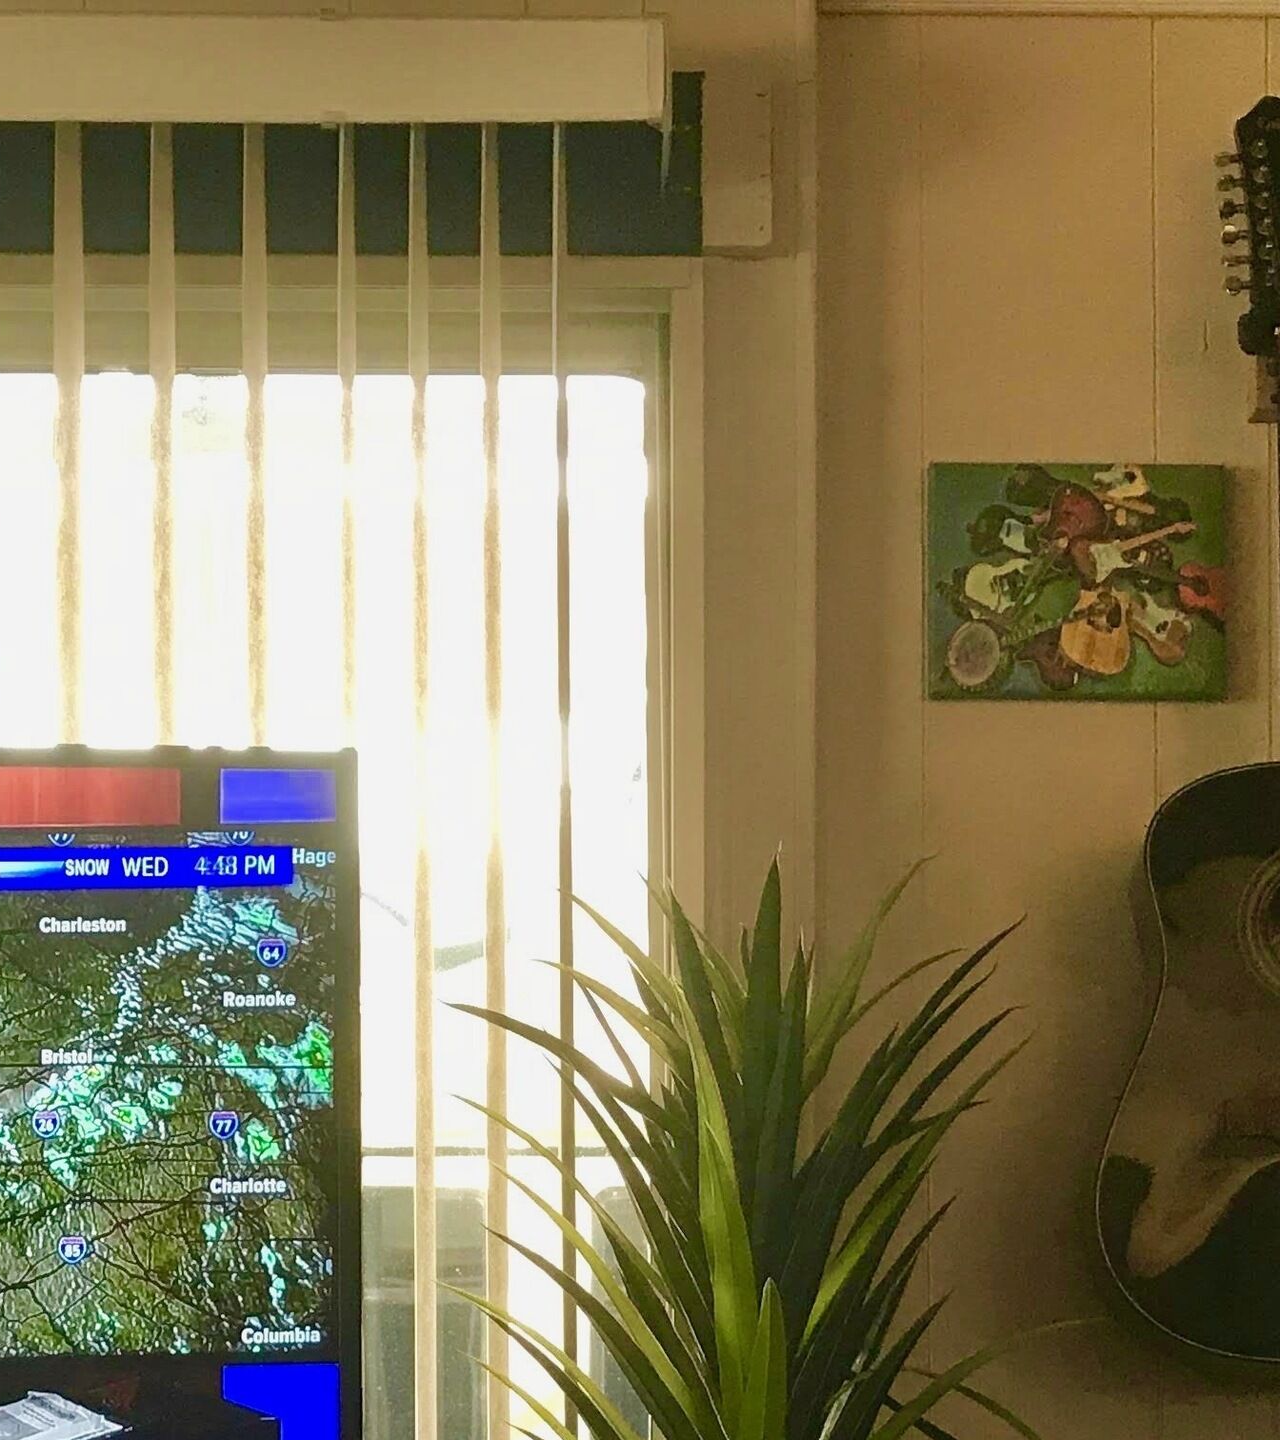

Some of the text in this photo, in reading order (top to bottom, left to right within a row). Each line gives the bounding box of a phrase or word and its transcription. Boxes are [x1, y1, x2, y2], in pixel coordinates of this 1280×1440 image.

[65, 858, 110, 876] SNOW
[121, 856, 169, 877] WED
[245, 854, 275, 875] PM
[39, 916, 127, 933] Charleston
[262, 947, 280, 961] 64
[222, 990, 296, 1007] Roanoke
[40, 1048, 93, 1065] Bristol
[38, 1118, 55, 1131] 26
[216, 1119, 233, 1132] 77
[209, 1177, 287, 1195] Charlotte
[241, 1325, 321, 1344] Columbia
